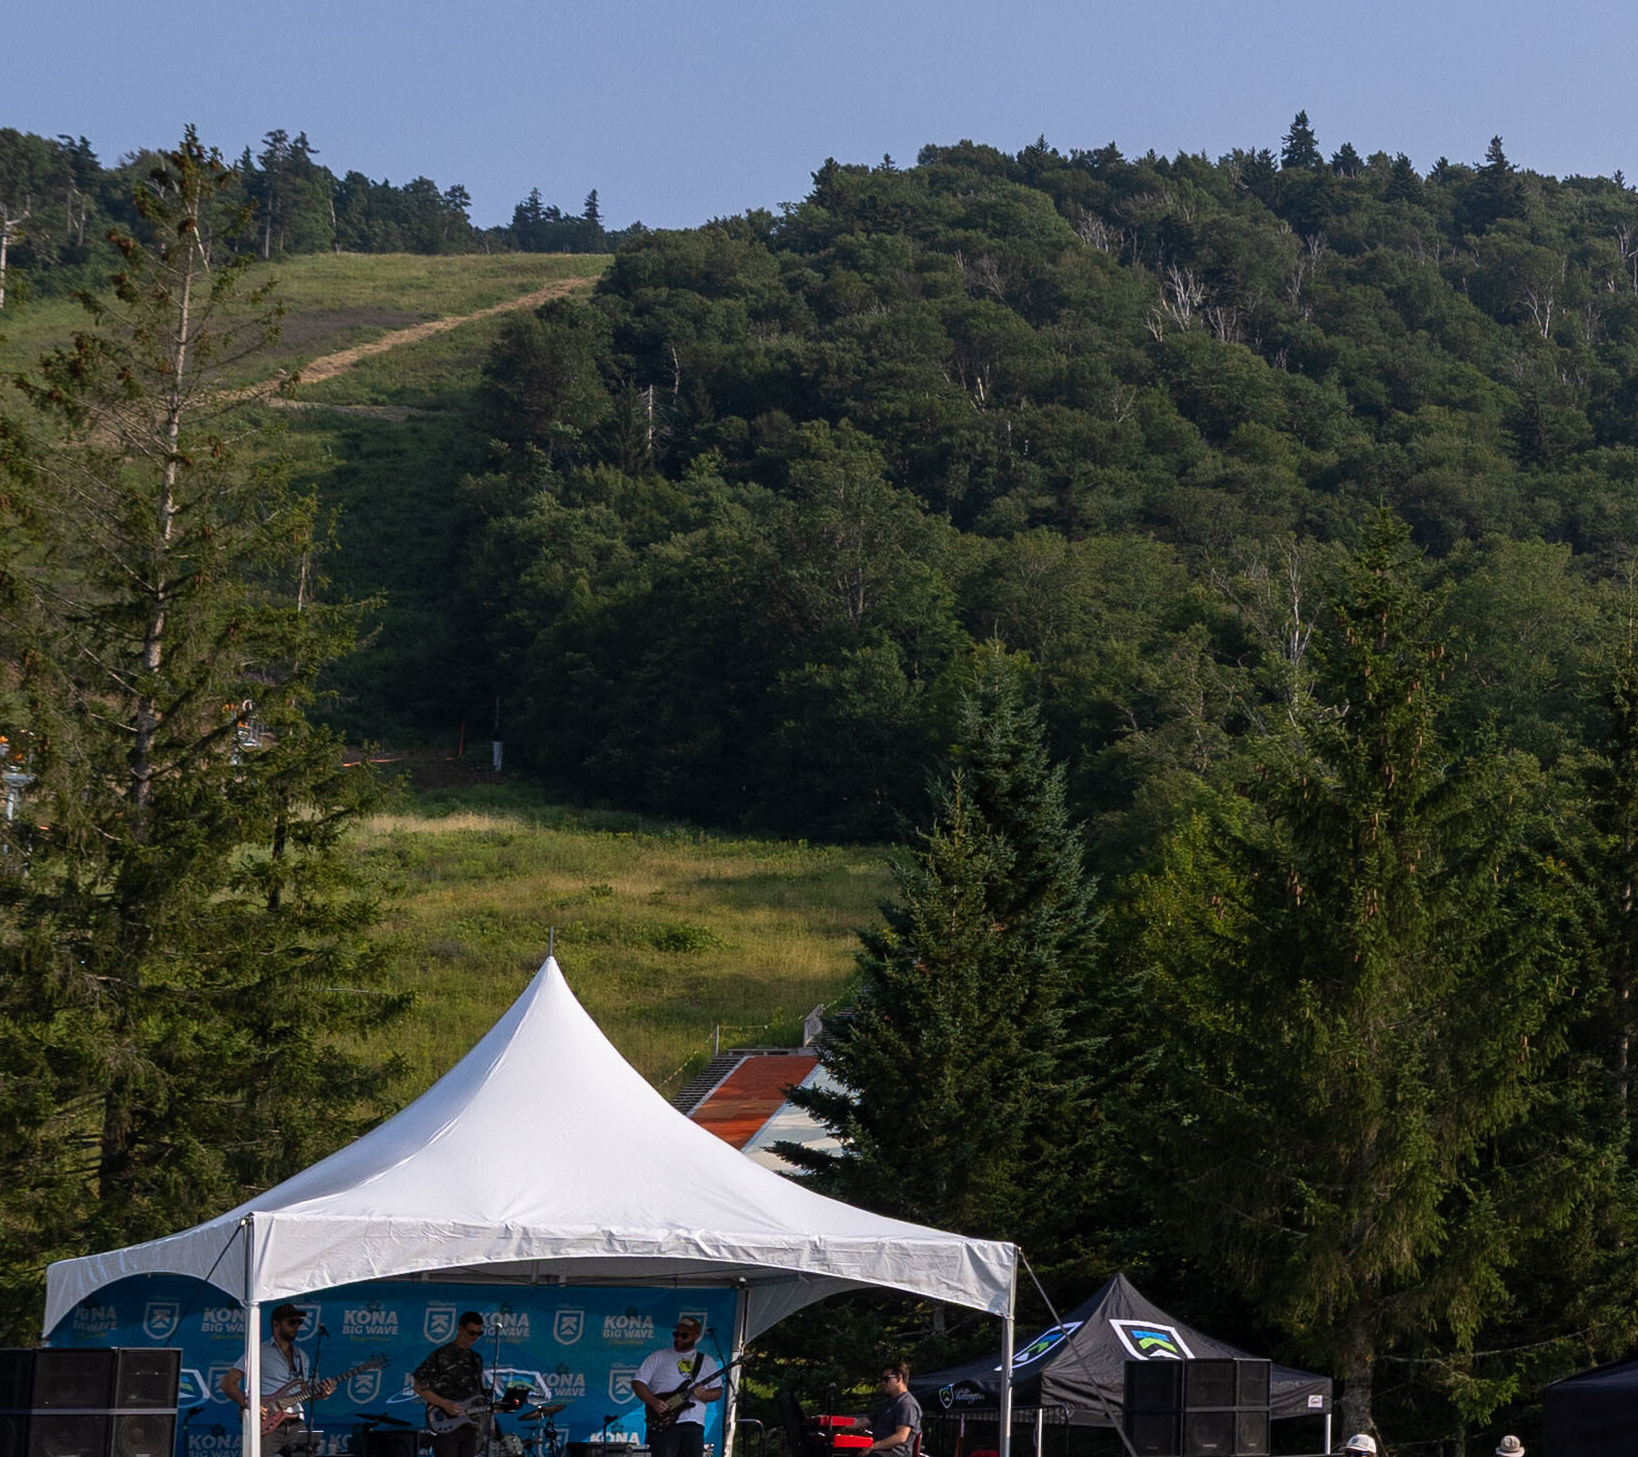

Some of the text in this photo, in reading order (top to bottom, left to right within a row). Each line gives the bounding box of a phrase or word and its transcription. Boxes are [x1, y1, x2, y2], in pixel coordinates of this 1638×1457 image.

[202, 1307, 246, 1322] KON
[343, 1310, 398, 1325] KONA
[604, 1315, 654, 1329] KONA
[342, 1325, 399, 1335] BIG WAVE
[603, 1329, 655, 1339] BIG WAVE
